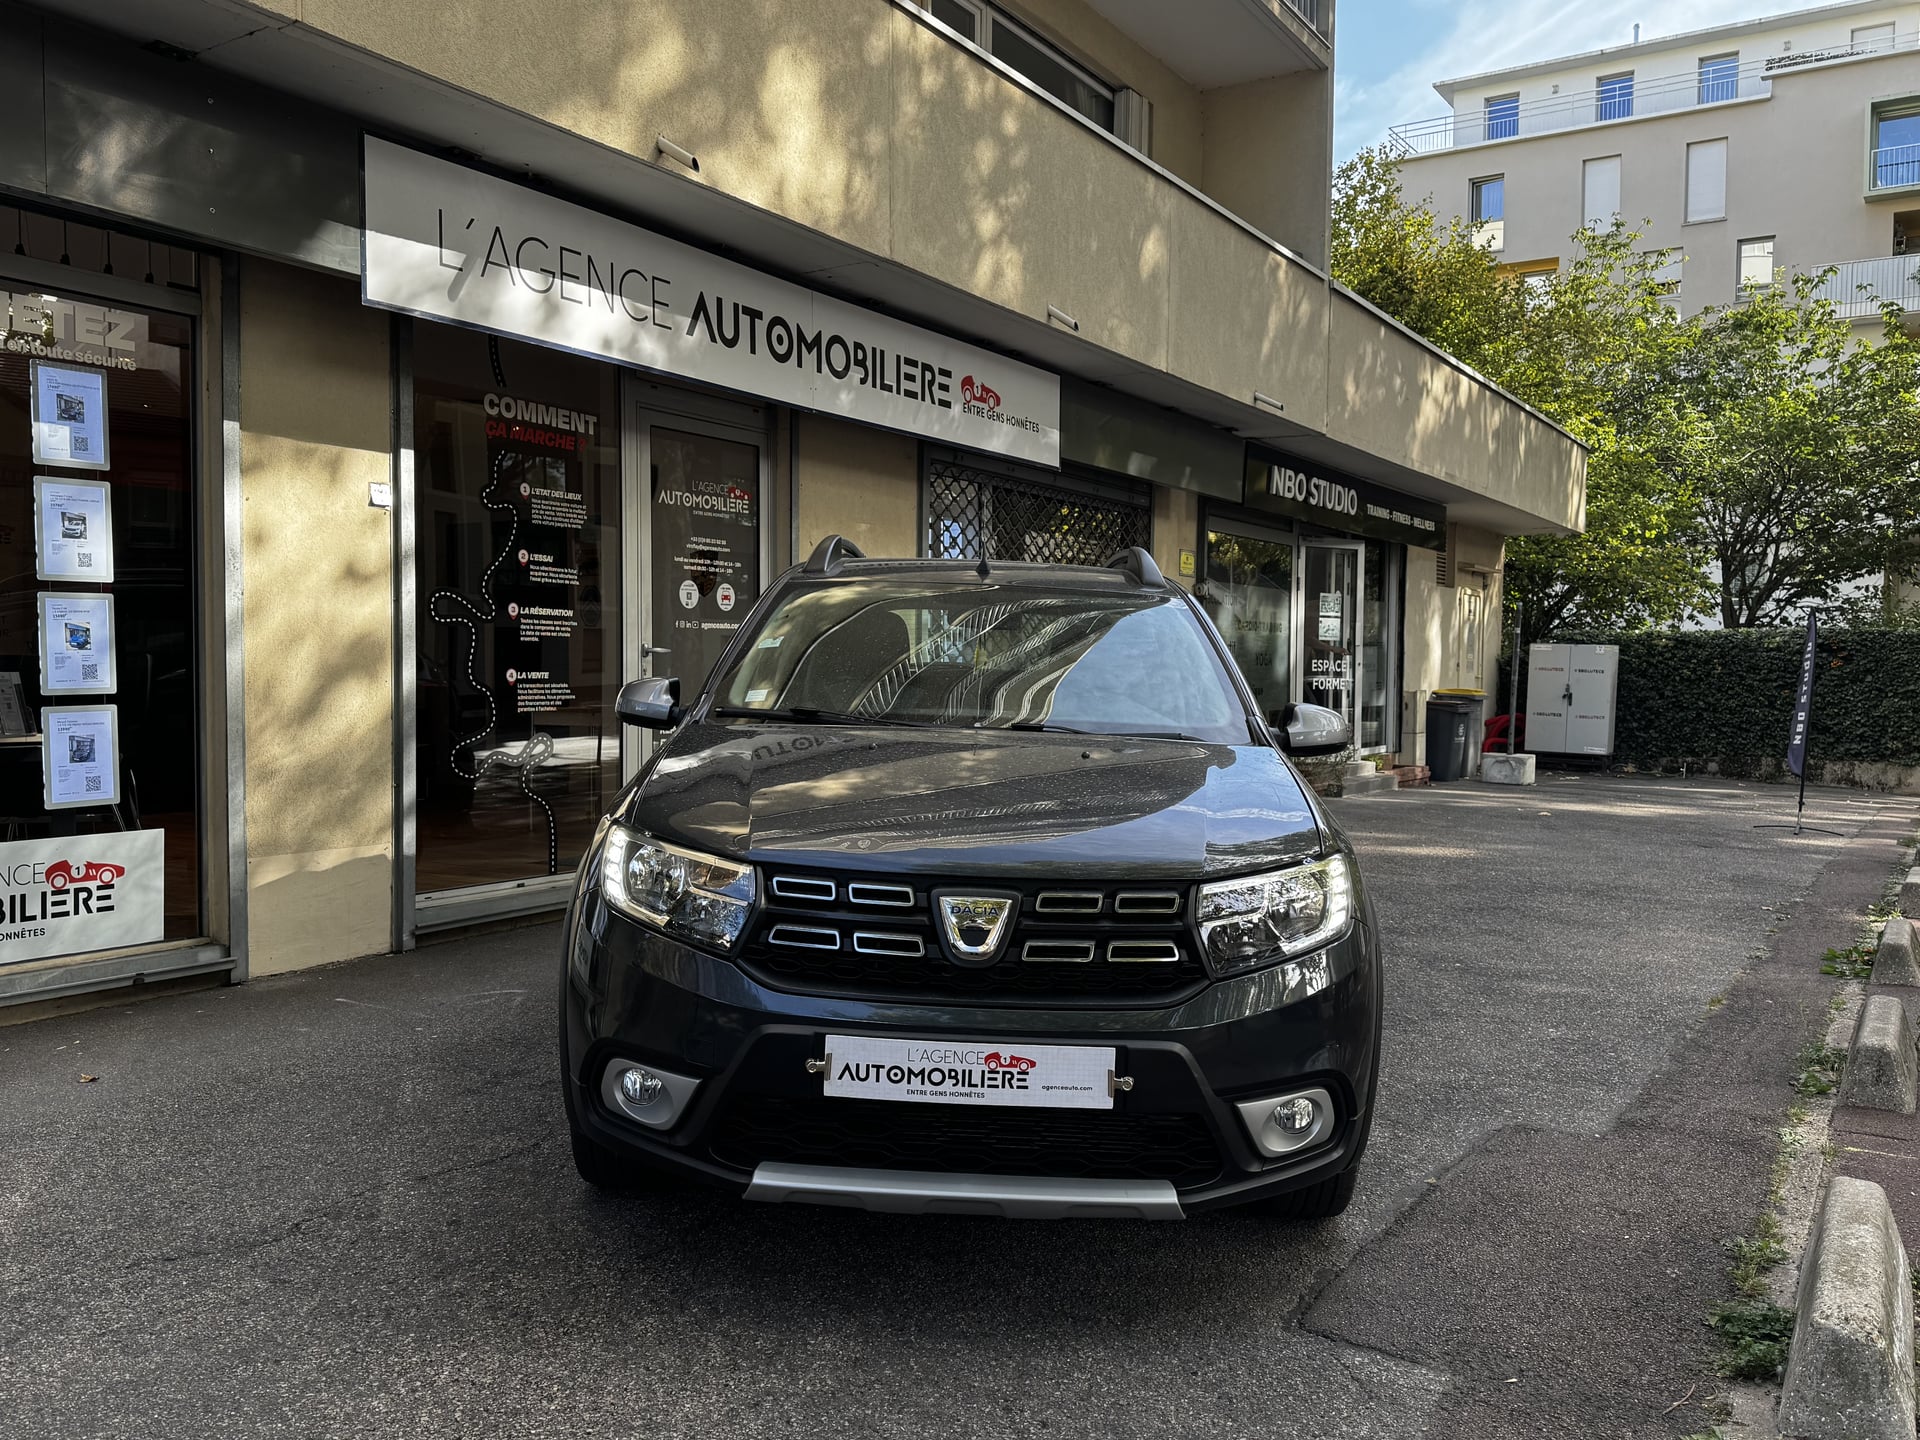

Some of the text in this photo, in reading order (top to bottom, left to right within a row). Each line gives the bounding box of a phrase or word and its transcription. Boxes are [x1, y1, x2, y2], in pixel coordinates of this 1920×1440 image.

[438, 208, 953, 410] L'AGENCE AUTOMOBILIERE
[0, 292, 136, 352] ETEZ
[30, 340, 73, 360] toute
[75, 350, 137, 371] sécurité
[483, 392, 598, 436] COMMENT
[962, 402, 1040, 433] ENTRE GENS HONNÊTES
[485, 420, 508, 441] ÇA
[509, 423, 576, 451] MARCHE
[551, 490, 564, 498] DES
[565, 492, 582, 501] LIEUX
[692, 479, 729, 496] L'AGENCE
[1271, 465, 1358, 516] NBO STUDIO
[658, 489, 750, 514] AUTOMOBILIERE
[1366, 503, 1390, 520] TRAINING
[1392, 511, 1411, 526] FITNESS
[530, 553, 554, 563] L'ESSAI
[520, 606, 529, 614] LA
[530, 606, 574, 617] RÉSERVATION
[701, 622, 740, 630] agenceauto.co
[1311, 659, 1347, 672] ESPACE
[518, 671, 526, 679] LA
[527, 671, 550, 679] VENTE
[1312, 678, 1347, 690] FORME
[1793, 711, 1806, 745] NBO
[951, 906, 999, 916] DACIA
[907, 1048, 985, 1066] L'AGENCE
[837, 1062, 1030, 1090] AUTOMOBILIERE
[907, 1088, 985, 1099] ENTRE GENS HONNÊTES
[1041, 1085, 1093, 1093] agenceauto.com
